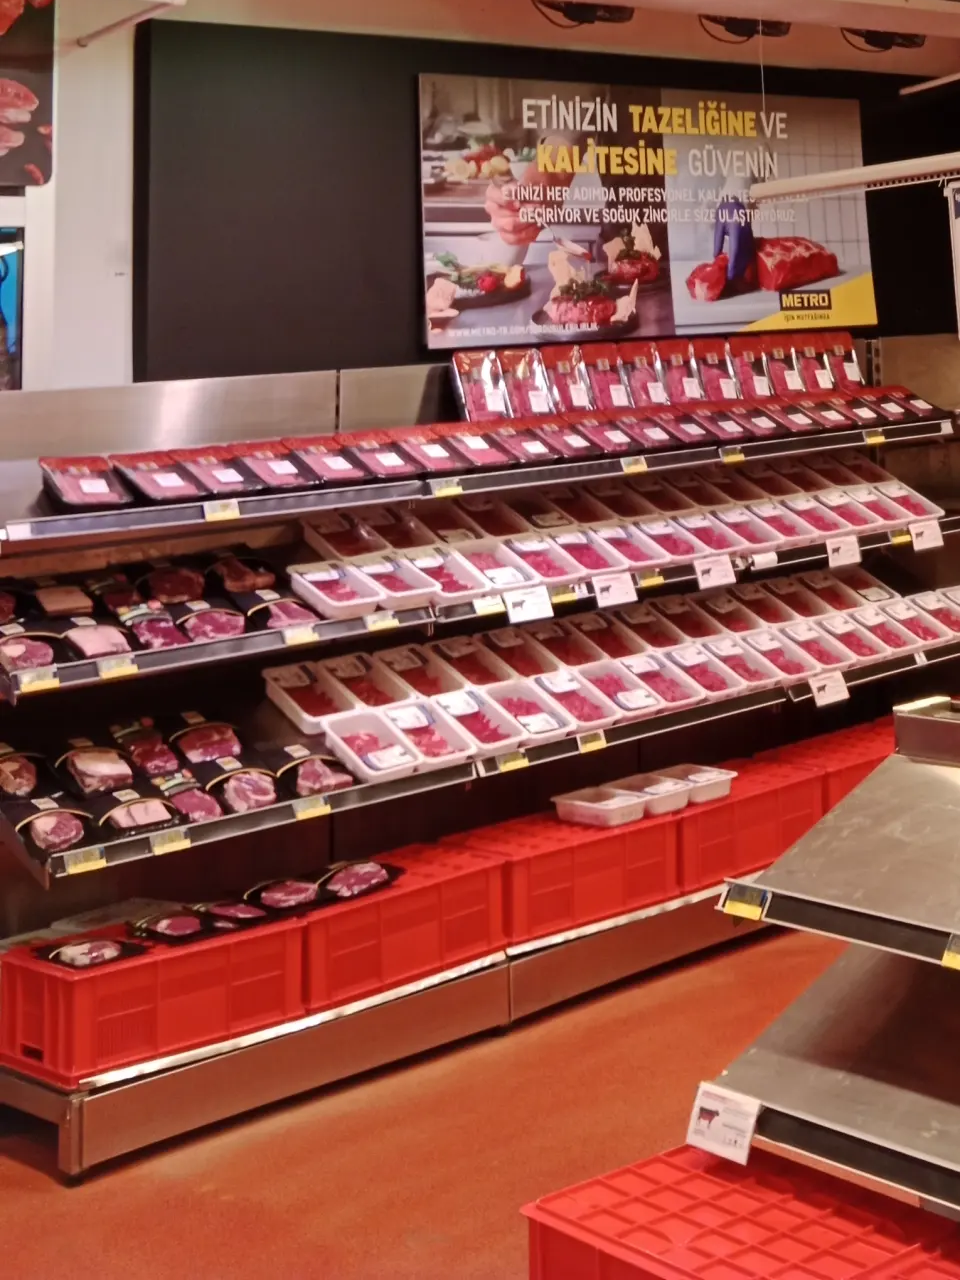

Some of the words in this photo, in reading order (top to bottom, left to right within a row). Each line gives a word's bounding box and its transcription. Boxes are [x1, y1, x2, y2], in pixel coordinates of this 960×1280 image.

[522, 94, 618, 132] ETİNİZİN
[628, 100, 757, 137] TAZELİĞİNE
[760, 111, 788, 139] VE
[537, 138, 677, 176] KALİTESİNE
[688, 144, 778, 179] GÜVENİN
[502, 183, 543, 202] ETİNİZİ
[546, 186, 570, 202] HER
[572, 187, 616, 203] ADIMDA
[618, 186, 696, 203] PROFESYONEL
[519, 206, 581, 227] GEÇİRİYOR
[584, 208, 600, 222] VE
[602, 205, 641, 223] SOĞUK
[643, 205, 691, 223] ZİNCİRLE
[781, 292, 829, 308] METRO
